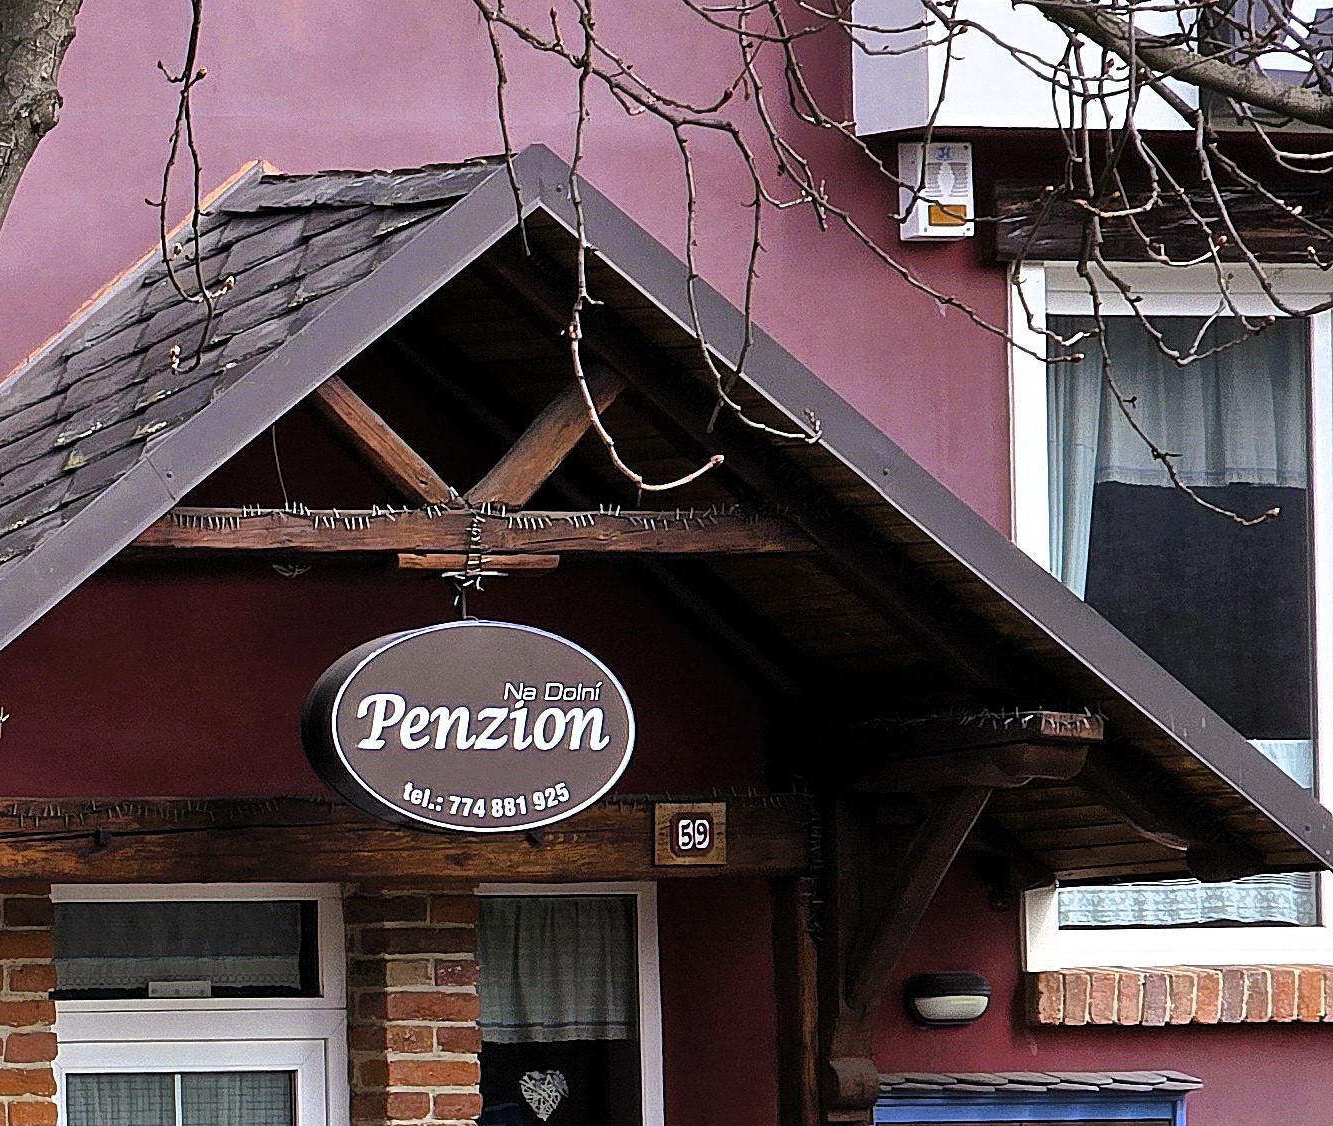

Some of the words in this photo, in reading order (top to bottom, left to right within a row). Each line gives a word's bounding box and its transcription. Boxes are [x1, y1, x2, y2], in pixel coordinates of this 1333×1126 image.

[503, 682, 537, 701] Na
[543, 681, 603, 701] Dolní
[356, 692, 611, 751] Penzion
[402, 781, 444, 812] tel.:
[449, 795, 486, 818] 774
[491, 795, 528, 818] 881
[532, 782, 570, 811] 925
[680, 821, 709, 848] 59
